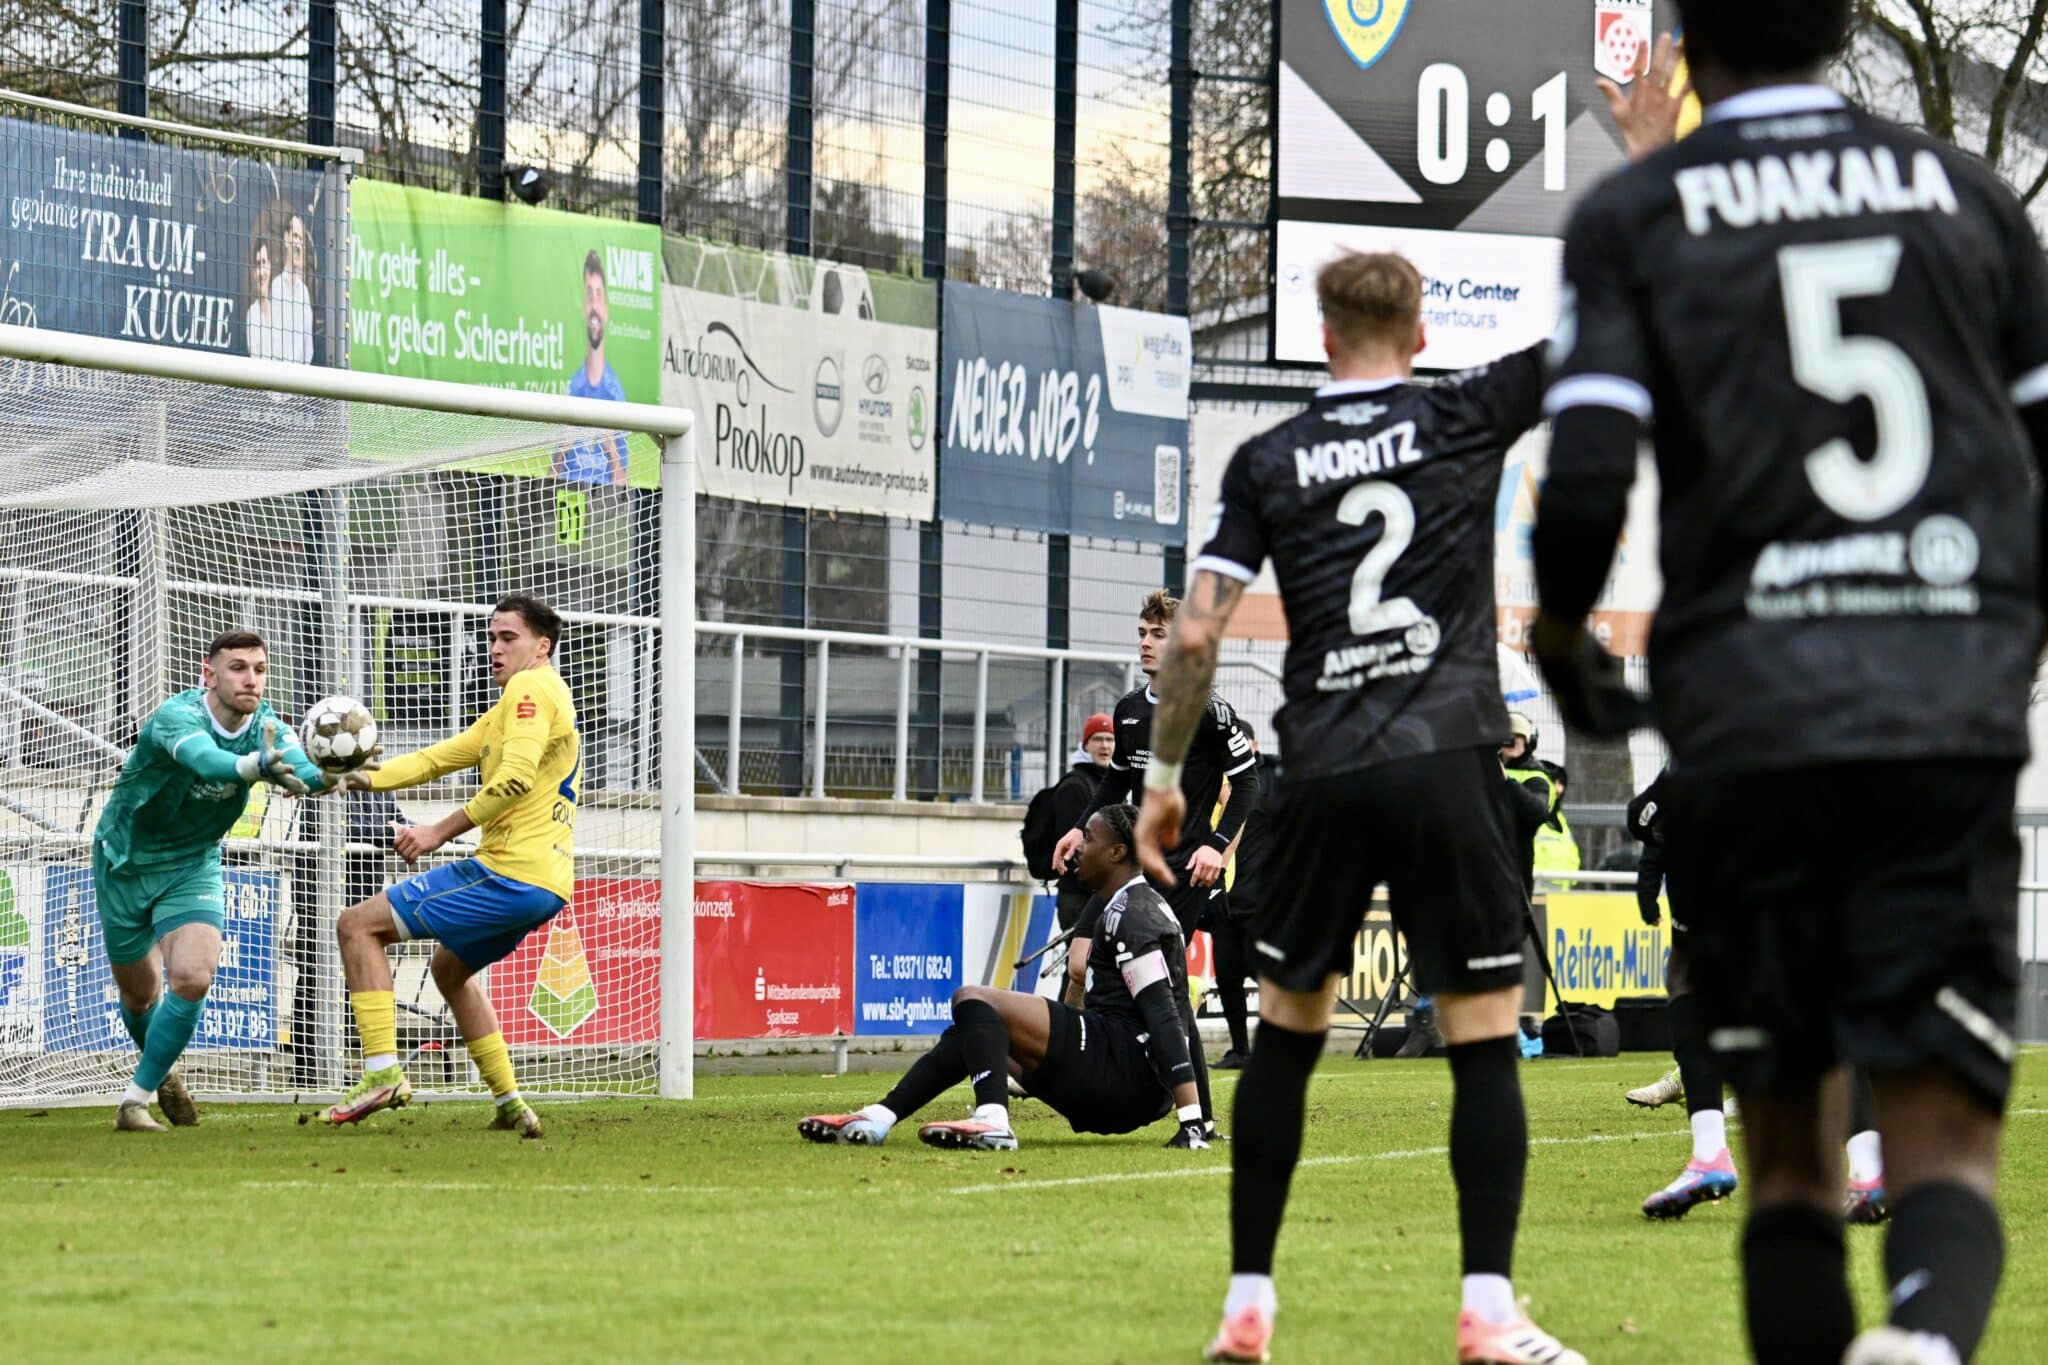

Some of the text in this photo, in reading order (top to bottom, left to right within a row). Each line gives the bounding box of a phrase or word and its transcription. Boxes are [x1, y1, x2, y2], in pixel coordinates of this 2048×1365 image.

[53, 156, 172, 207] Ihre individuell
[1674, 146, 1959, 236] FUAKALA
[12, 190, 206, 275] geplante TRAUM-
[351, 234, 375, 282] Ihr
[379, 242, 421, 298] gebt
[428, 248, 465, 296] alles
[1420, 276, 1520, 302] City Center
[121, 274, 233, 349] KÜCHE
[351, 296, 563, 370] wir geben Sicherheit!
[1776, 235, 1934, 523] 5
[809, 462, 928, 497] www.autoforum-prokop.de
[1295, 420, 1423, 488] MORITZ
[1336, 480, 1428, 636] 2
[598, 896, 735, 923] Das Sparkasse konzept.
[926, 954, 953, 980] 682-0
[1555, 928, 1671, 990] Reifen-Mülle
[766, 984, 841, 1004] Mittelbrandenburgische
[766, 1008, 799, 1028] Sparkasse
